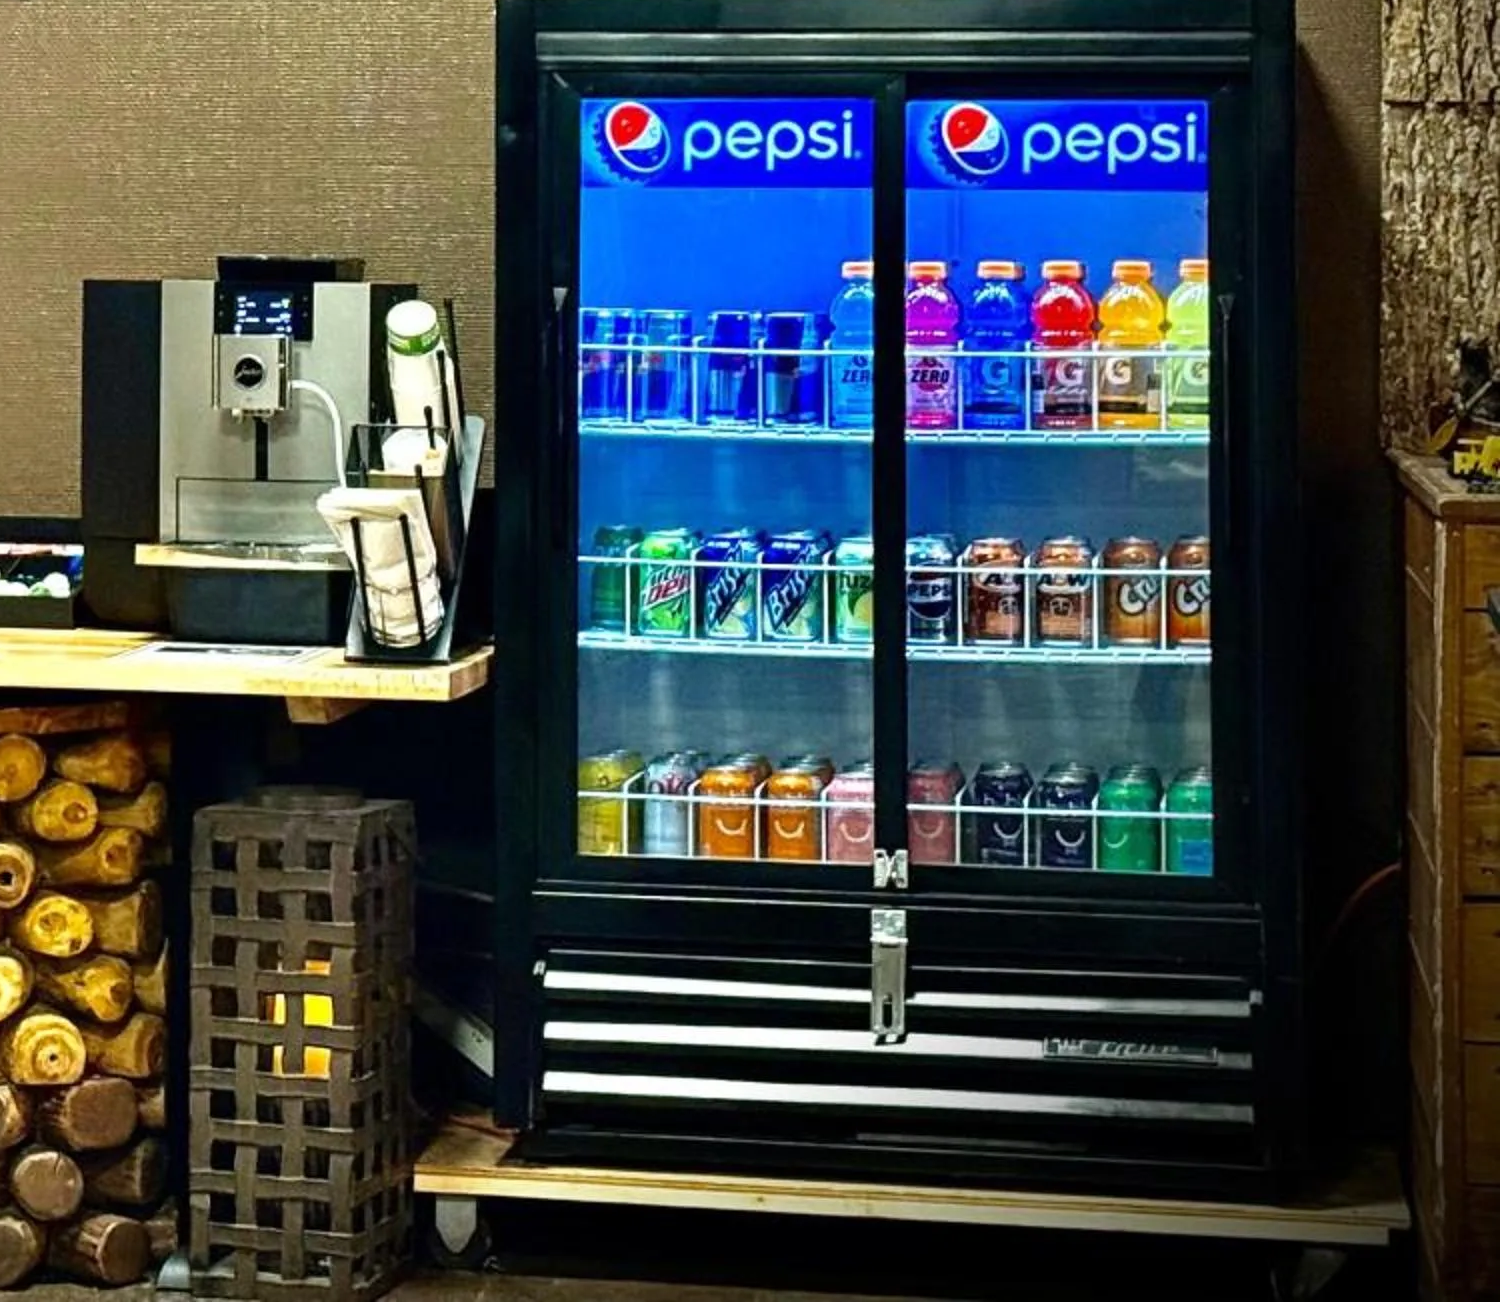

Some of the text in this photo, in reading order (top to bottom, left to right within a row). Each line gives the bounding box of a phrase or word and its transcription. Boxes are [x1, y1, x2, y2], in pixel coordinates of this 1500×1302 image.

[683, 109, 853, 171] pepsi
[1022, 111, 1198, 175] pepsi
[1055, 357, 1086, 386] G
[1105, 357, 1132, 385] G
